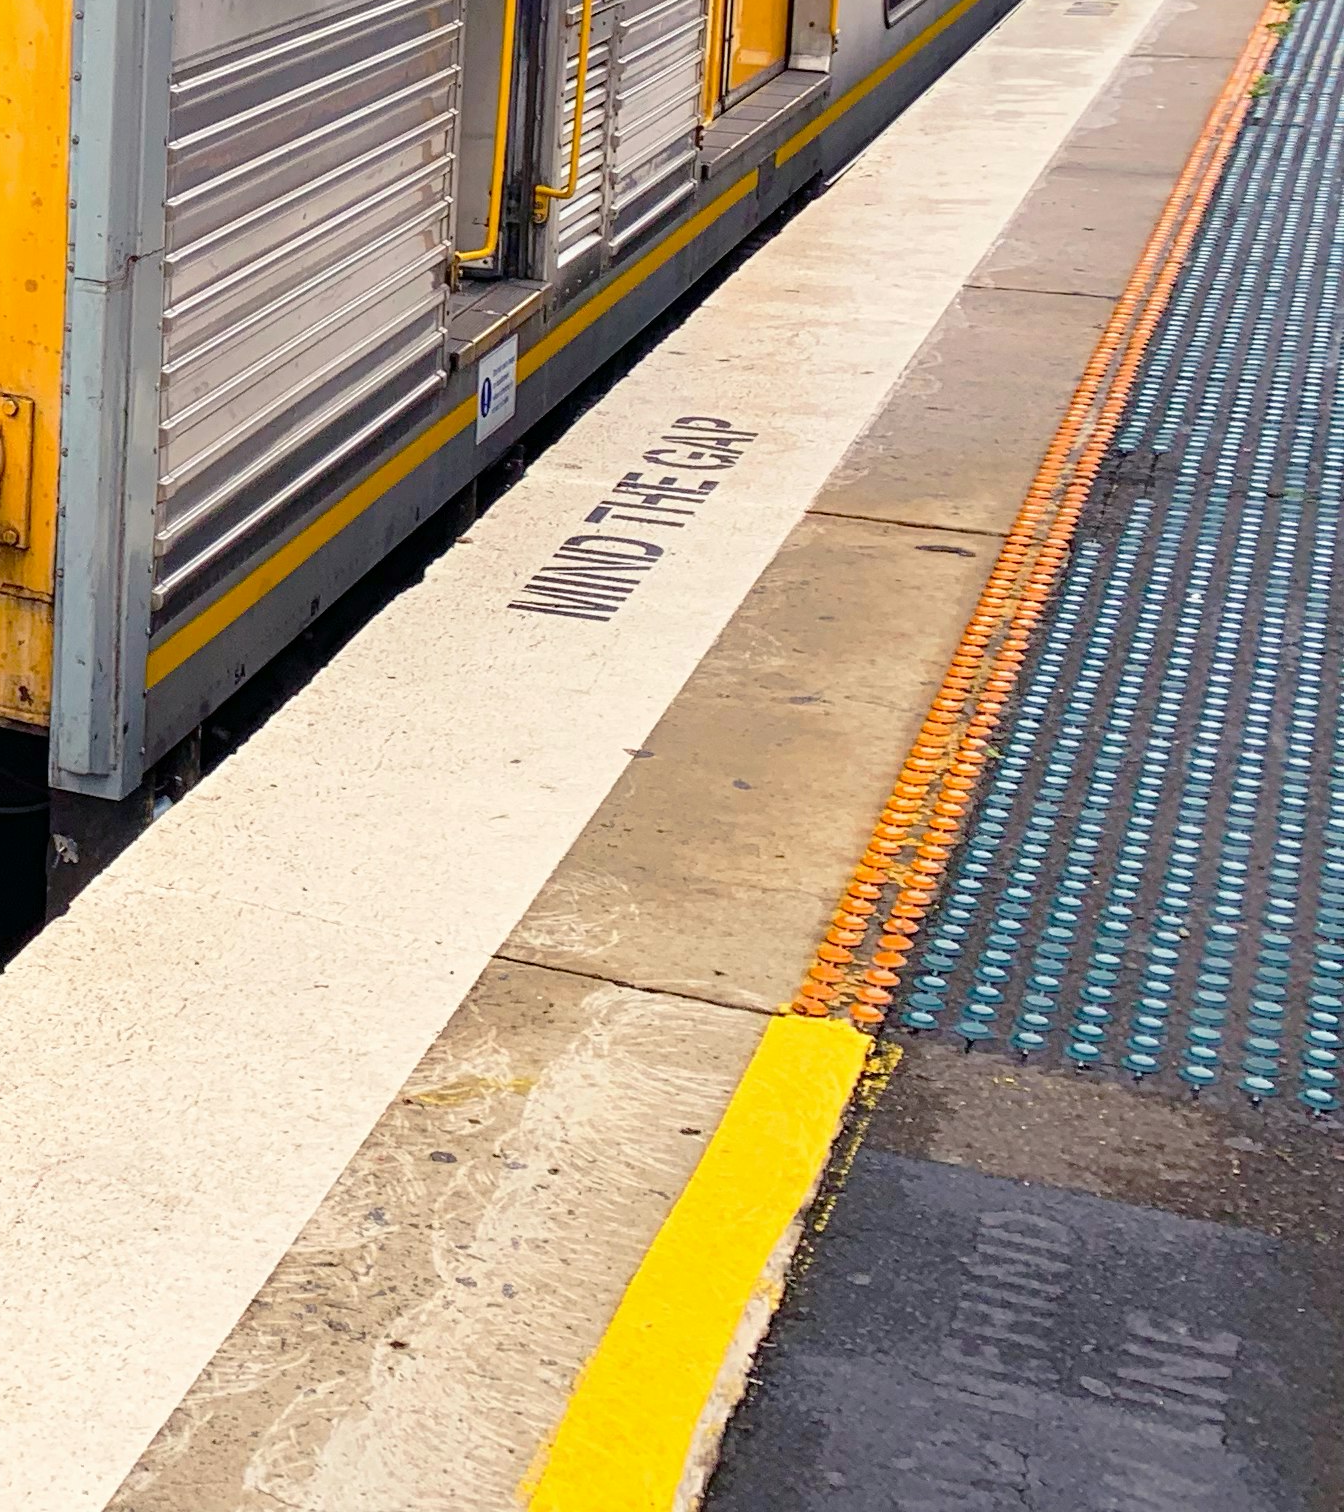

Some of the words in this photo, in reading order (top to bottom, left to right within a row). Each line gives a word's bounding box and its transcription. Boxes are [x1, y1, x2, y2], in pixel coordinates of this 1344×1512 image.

[642, 416, 760, 470] GAP
[583, 472, 720, 528] THE
[506, 534, 665, 622] MIND
